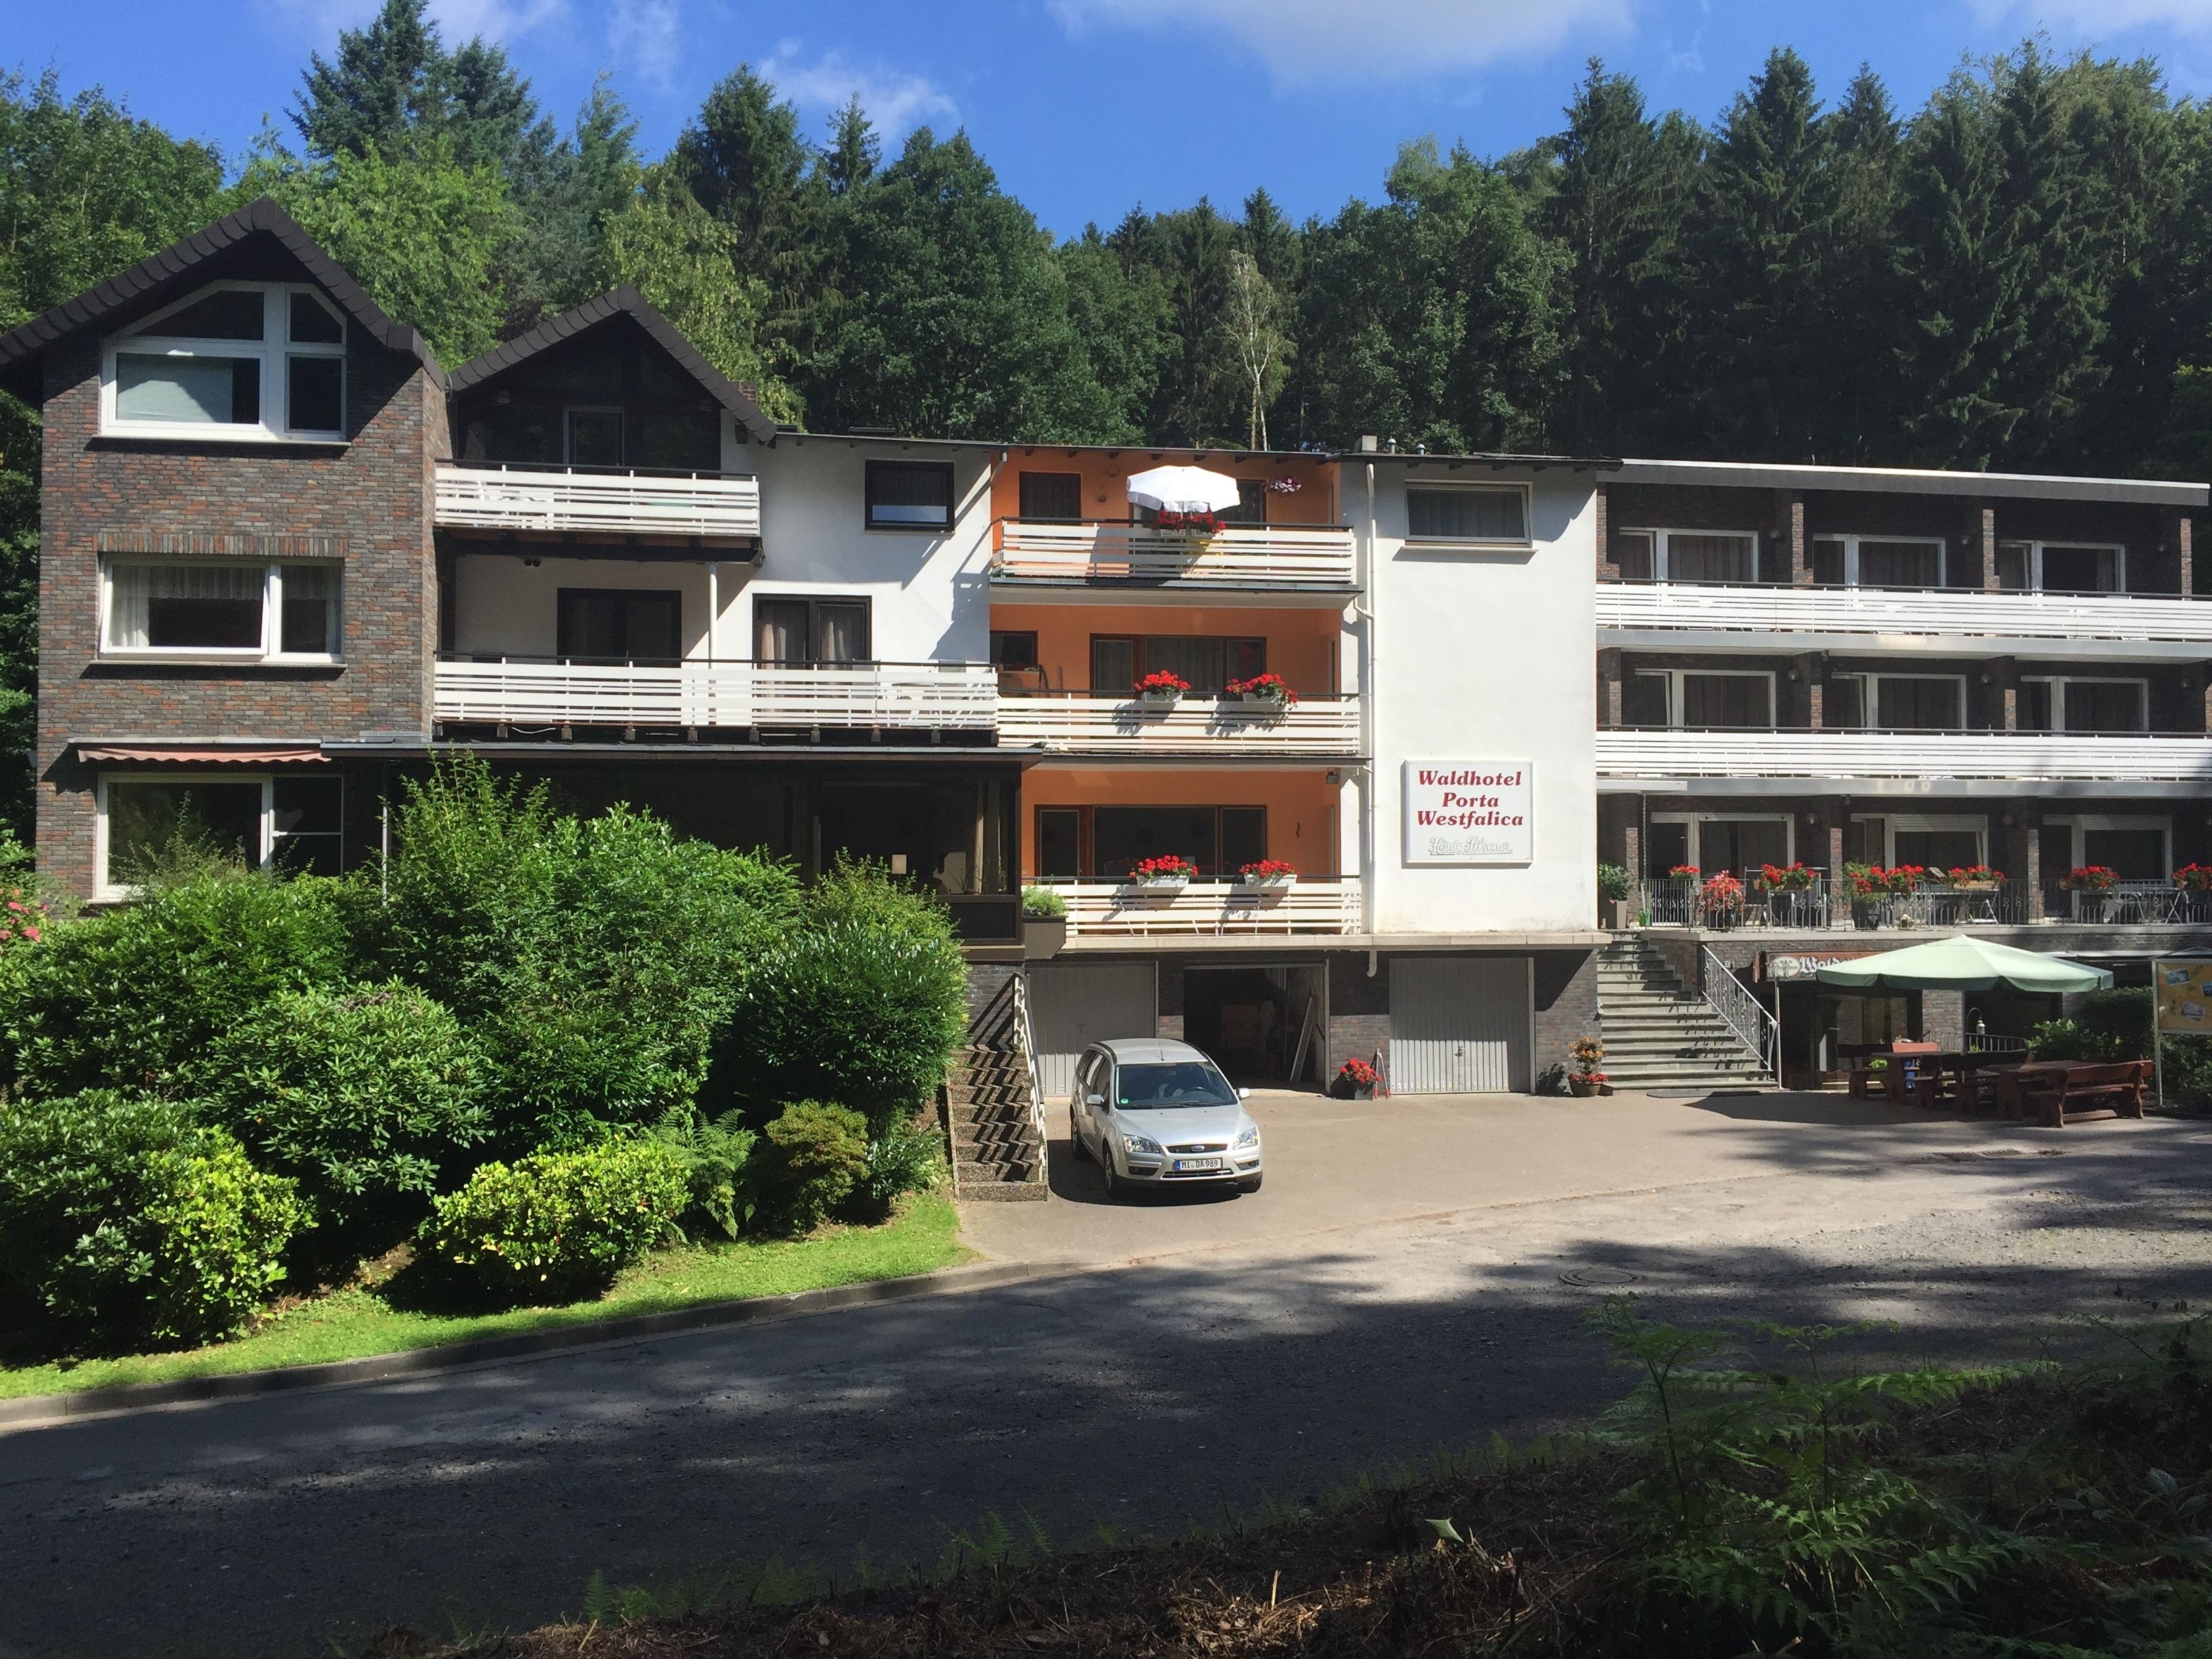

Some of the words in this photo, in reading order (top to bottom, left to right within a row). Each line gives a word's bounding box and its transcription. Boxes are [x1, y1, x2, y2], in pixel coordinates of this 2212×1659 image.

[1418, 771, 1521, 786] Waldhotel
[1442, 792, 1499, 807] Porta
[1417, 811, 1523, 830] Westfalica
